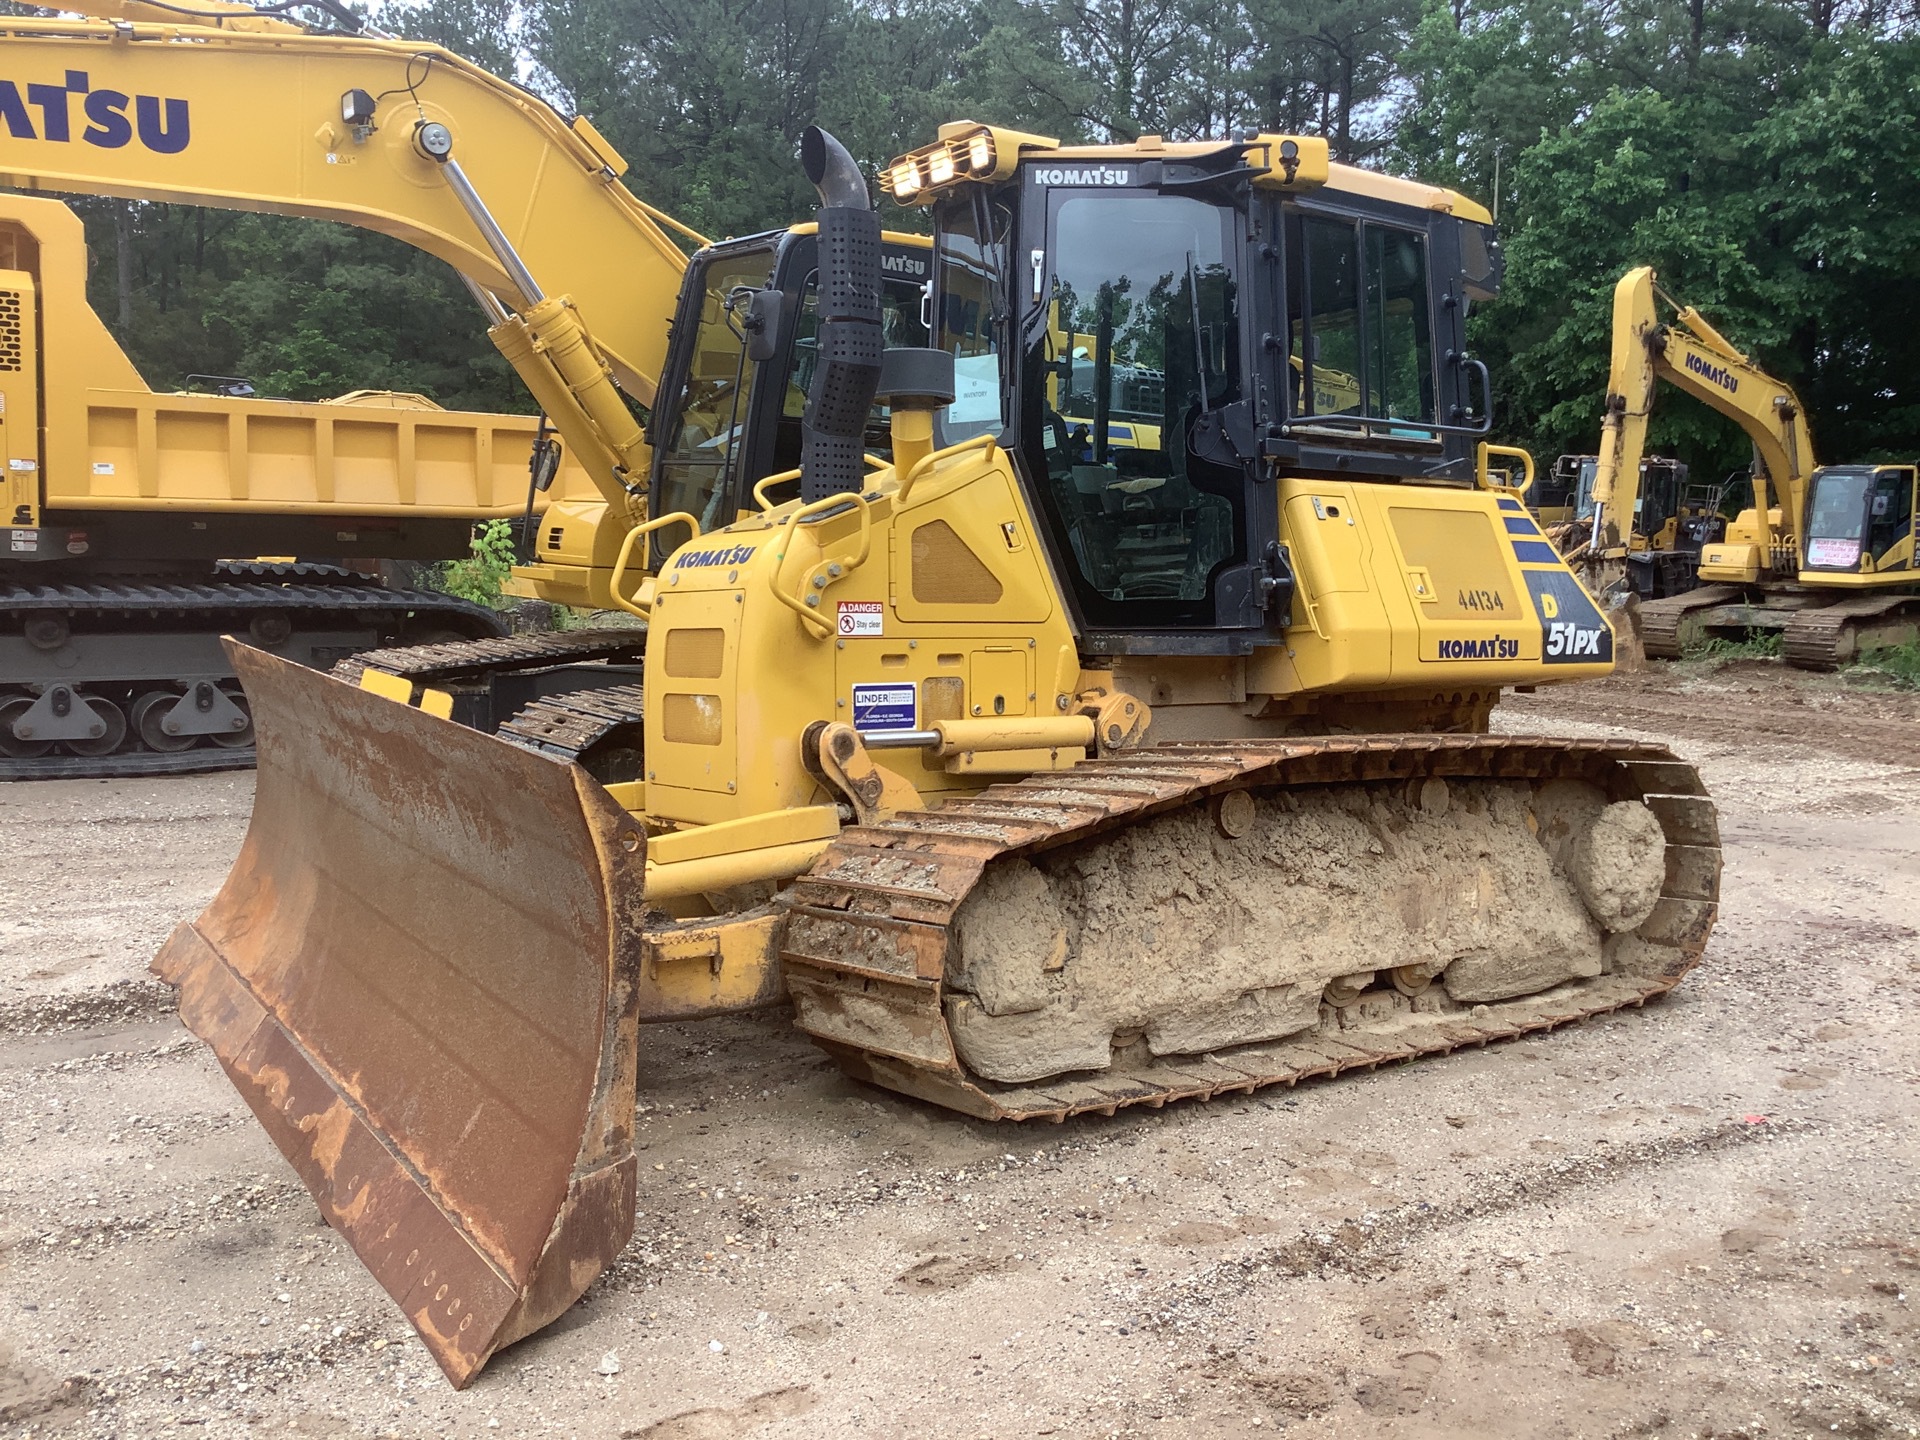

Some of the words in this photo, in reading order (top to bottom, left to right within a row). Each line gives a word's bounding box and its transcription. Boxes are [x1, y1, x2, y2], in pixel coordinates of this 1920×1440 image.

[1035, 166, 1128, 185] KOMATSU
[1685, 351, 1738, 393] KOMATSU
[674, 544, 757, 569] KOMATSU
[847, 603, 883, 612] DANGER
[1458, 589, 1505, 612] 44134
[1541, 594, 1558, 618] D
[856, 620, 867, 630] Stay
[868, 620, 881, 628] clear
[1438, 634, 1519, 659] KOMATSU
[1546, 622, 1602, 656] 51PX
[856, 693, 889, 704] LINDER
